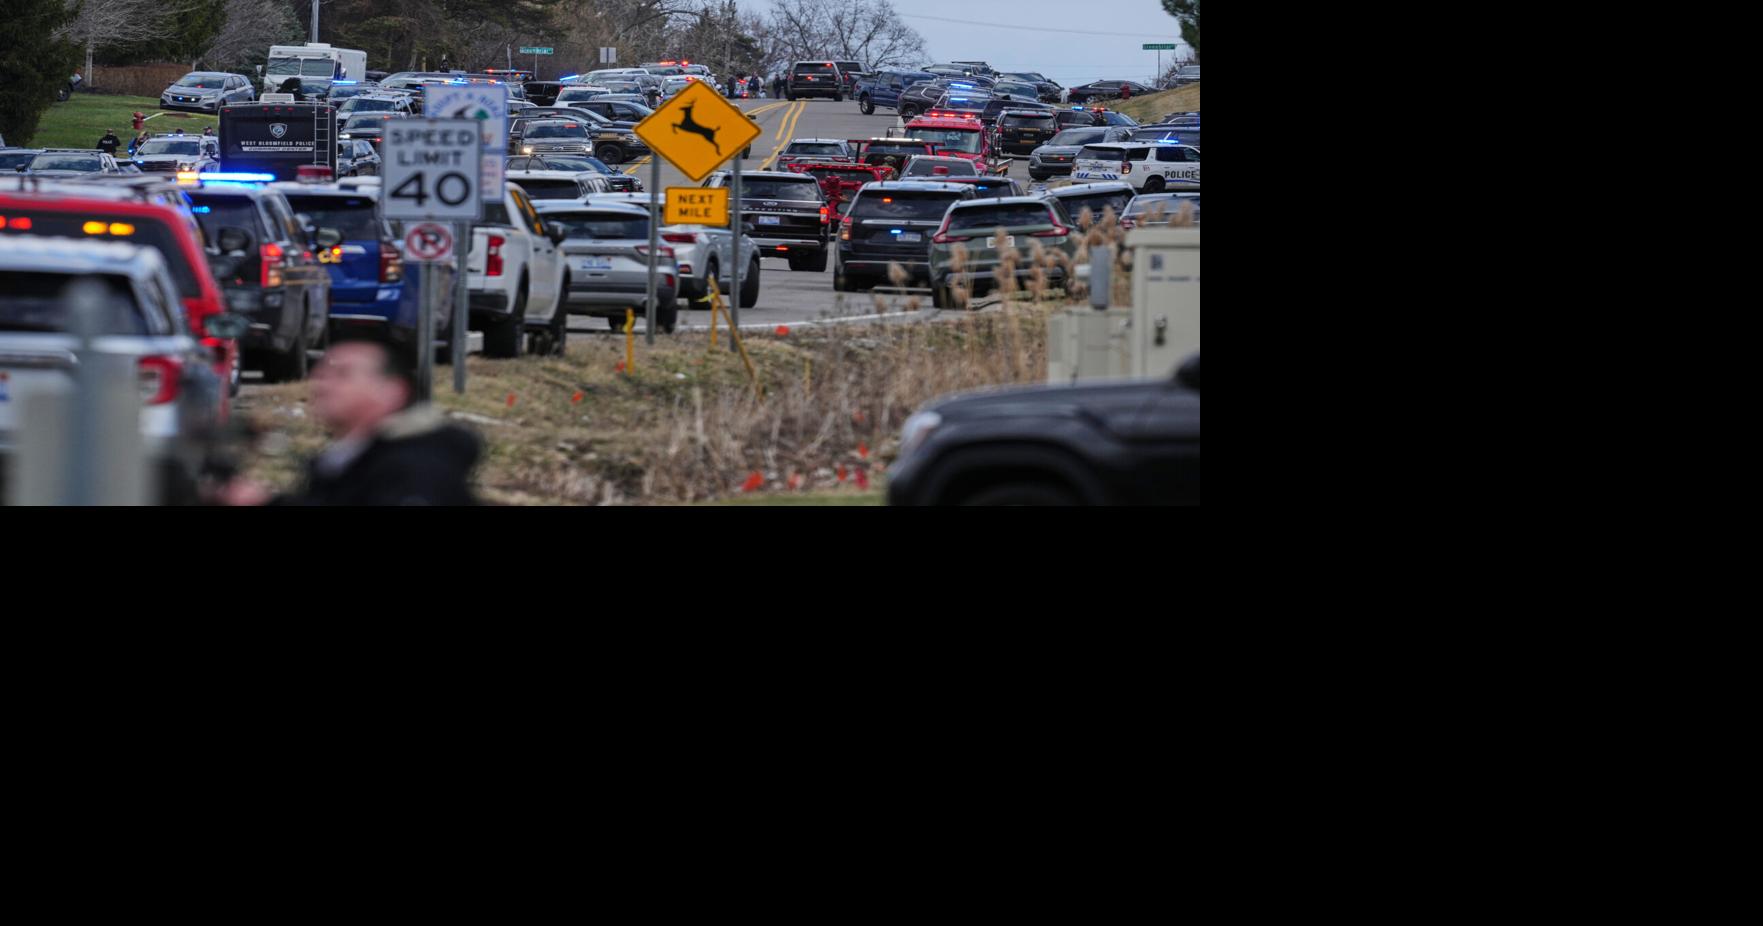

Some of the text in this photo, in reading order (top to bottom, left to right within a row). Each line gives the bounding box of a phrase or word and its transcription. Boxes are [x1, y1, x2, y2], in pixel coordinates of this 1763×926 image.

[390, 129, 475, 146] SPEED
[397, 151, 462, 166] LIMIT
[1164, 170, 1196, 178] POLICE
[390, 172, 471, 206] 40
[678, 195, 714, 204] NEXT
[678, 208, 712, 218] MILE
